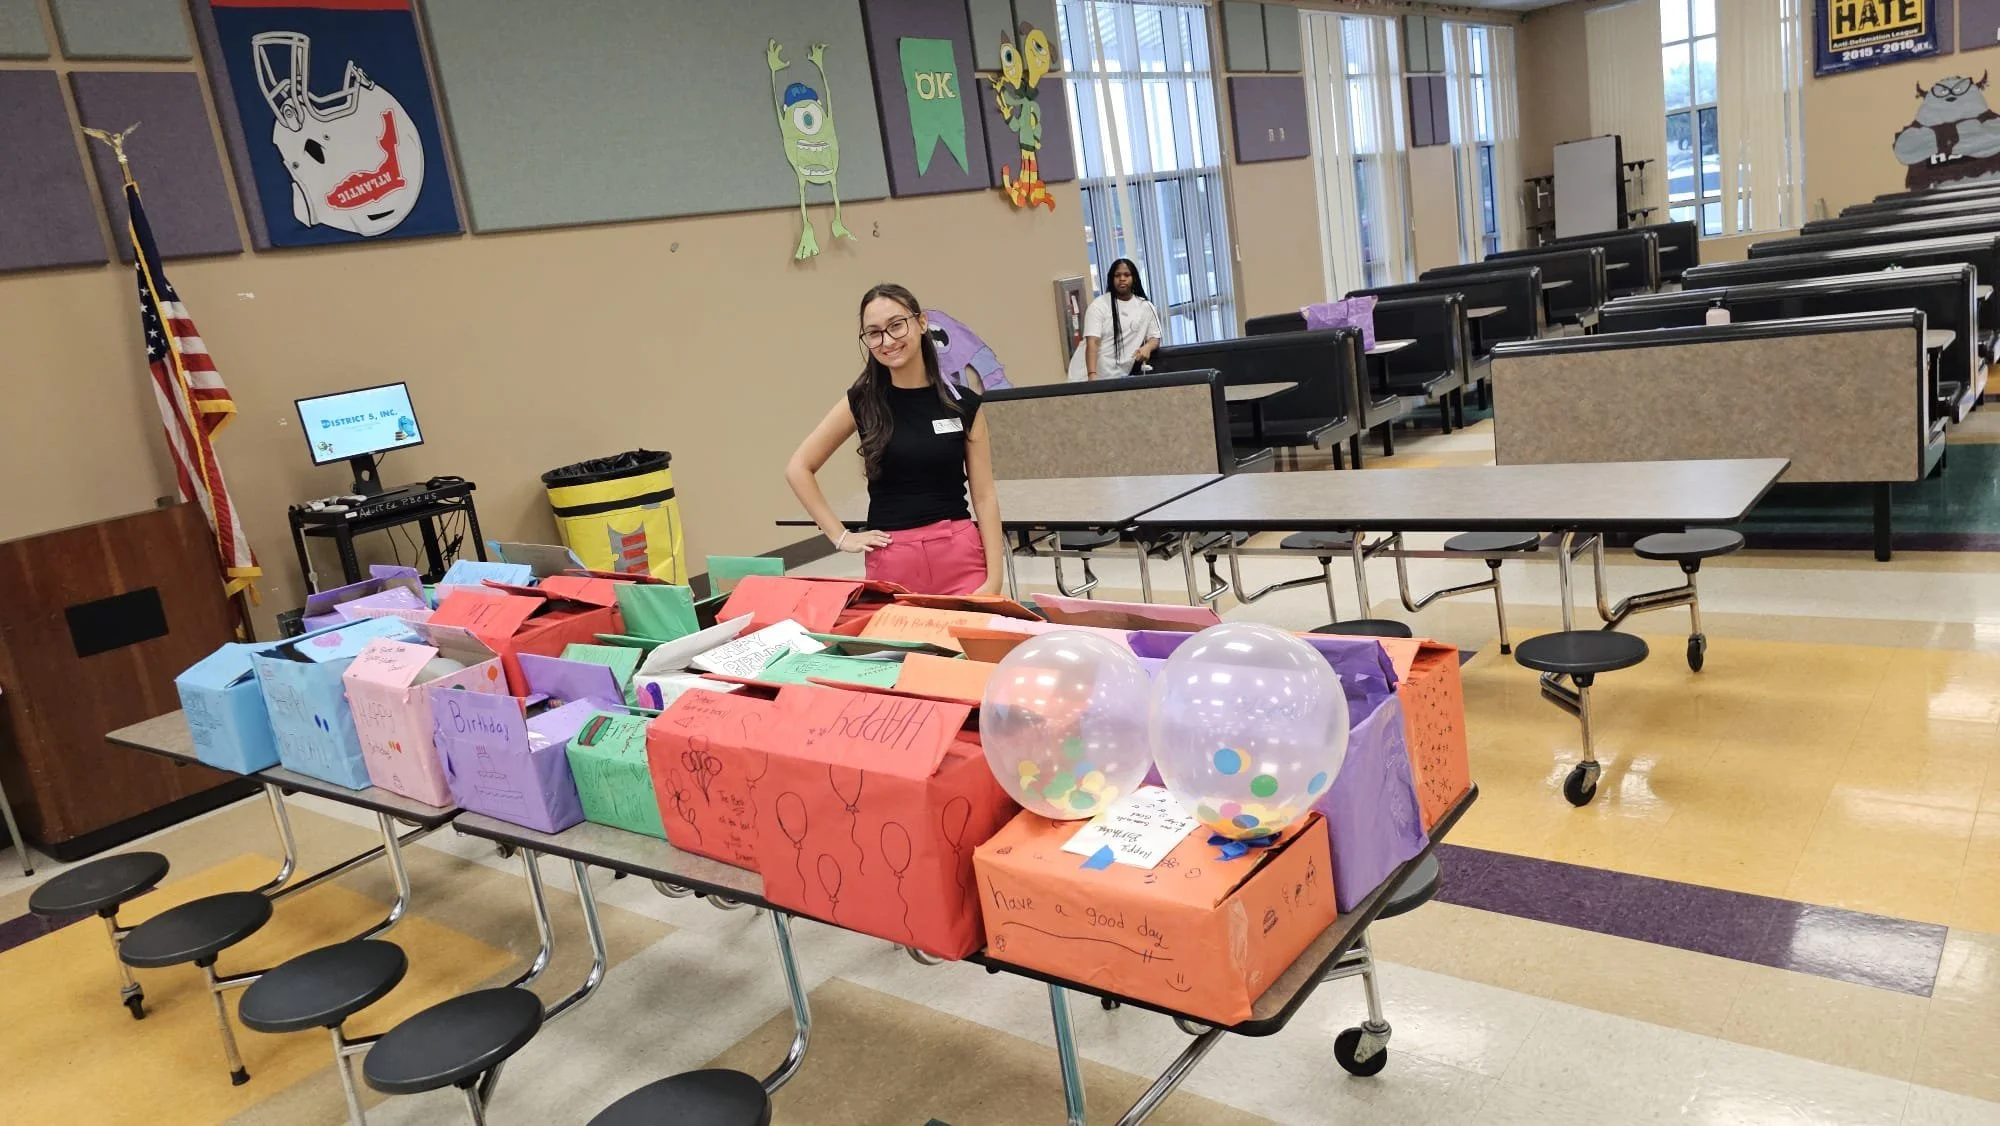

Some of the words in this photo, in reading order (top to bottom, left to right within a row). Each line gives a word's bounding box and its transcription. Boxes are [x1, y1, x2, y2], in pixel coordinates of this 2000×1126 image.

[1836, 0, 1918, 34] HATE
[1833, 33, 1891, 48] Anti-Defamation
[1891, 28, 1919, 38] League
[1842, 47, 1873, 61] 2015
[914, 71, 956, 100] OK
[338, 172, 392, 203] ATLANTIC
[321, 414, 365, 429] DISTRICT
[380, 408, 398, 418] INC.
[447, 699, 511, 743] Birthday
[1121, 844, 1153, 860] Happy
[987, 875, 1035, 912] have
[1055, 903, 1069, 918] a
[1085, 906, 1125, 929] good
[1136, 915, 1170, 950] day
